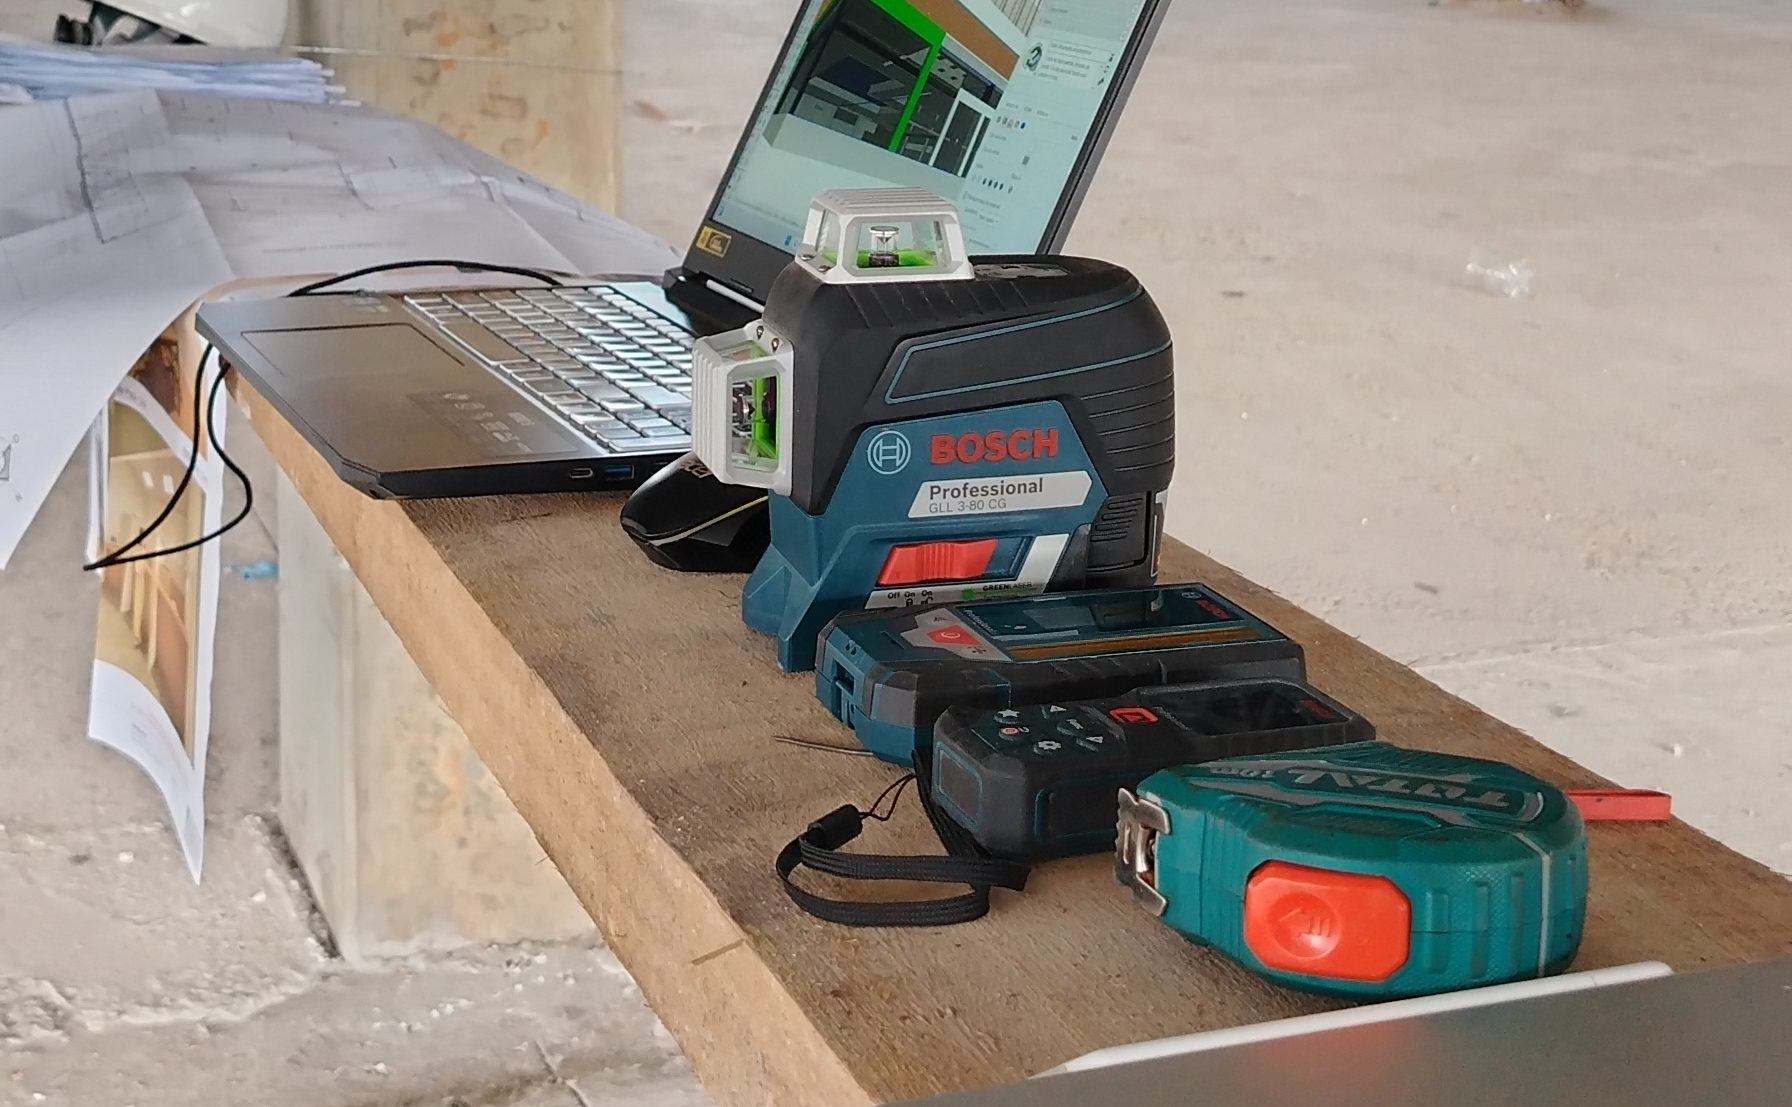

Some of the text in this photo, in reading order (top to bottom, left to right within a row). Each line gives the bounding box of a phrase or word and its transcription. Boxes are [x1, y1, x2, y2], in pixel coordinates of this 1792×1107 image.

[930, 428, 1058, 465] BOSCH
[929, 478, 1043, 500] Professional
[928, 497, 1007, 514] GLL 3-80 CG
[887, 589, 933, 600] Off On On
[1287, 767, 1511, 808] TOTAL
